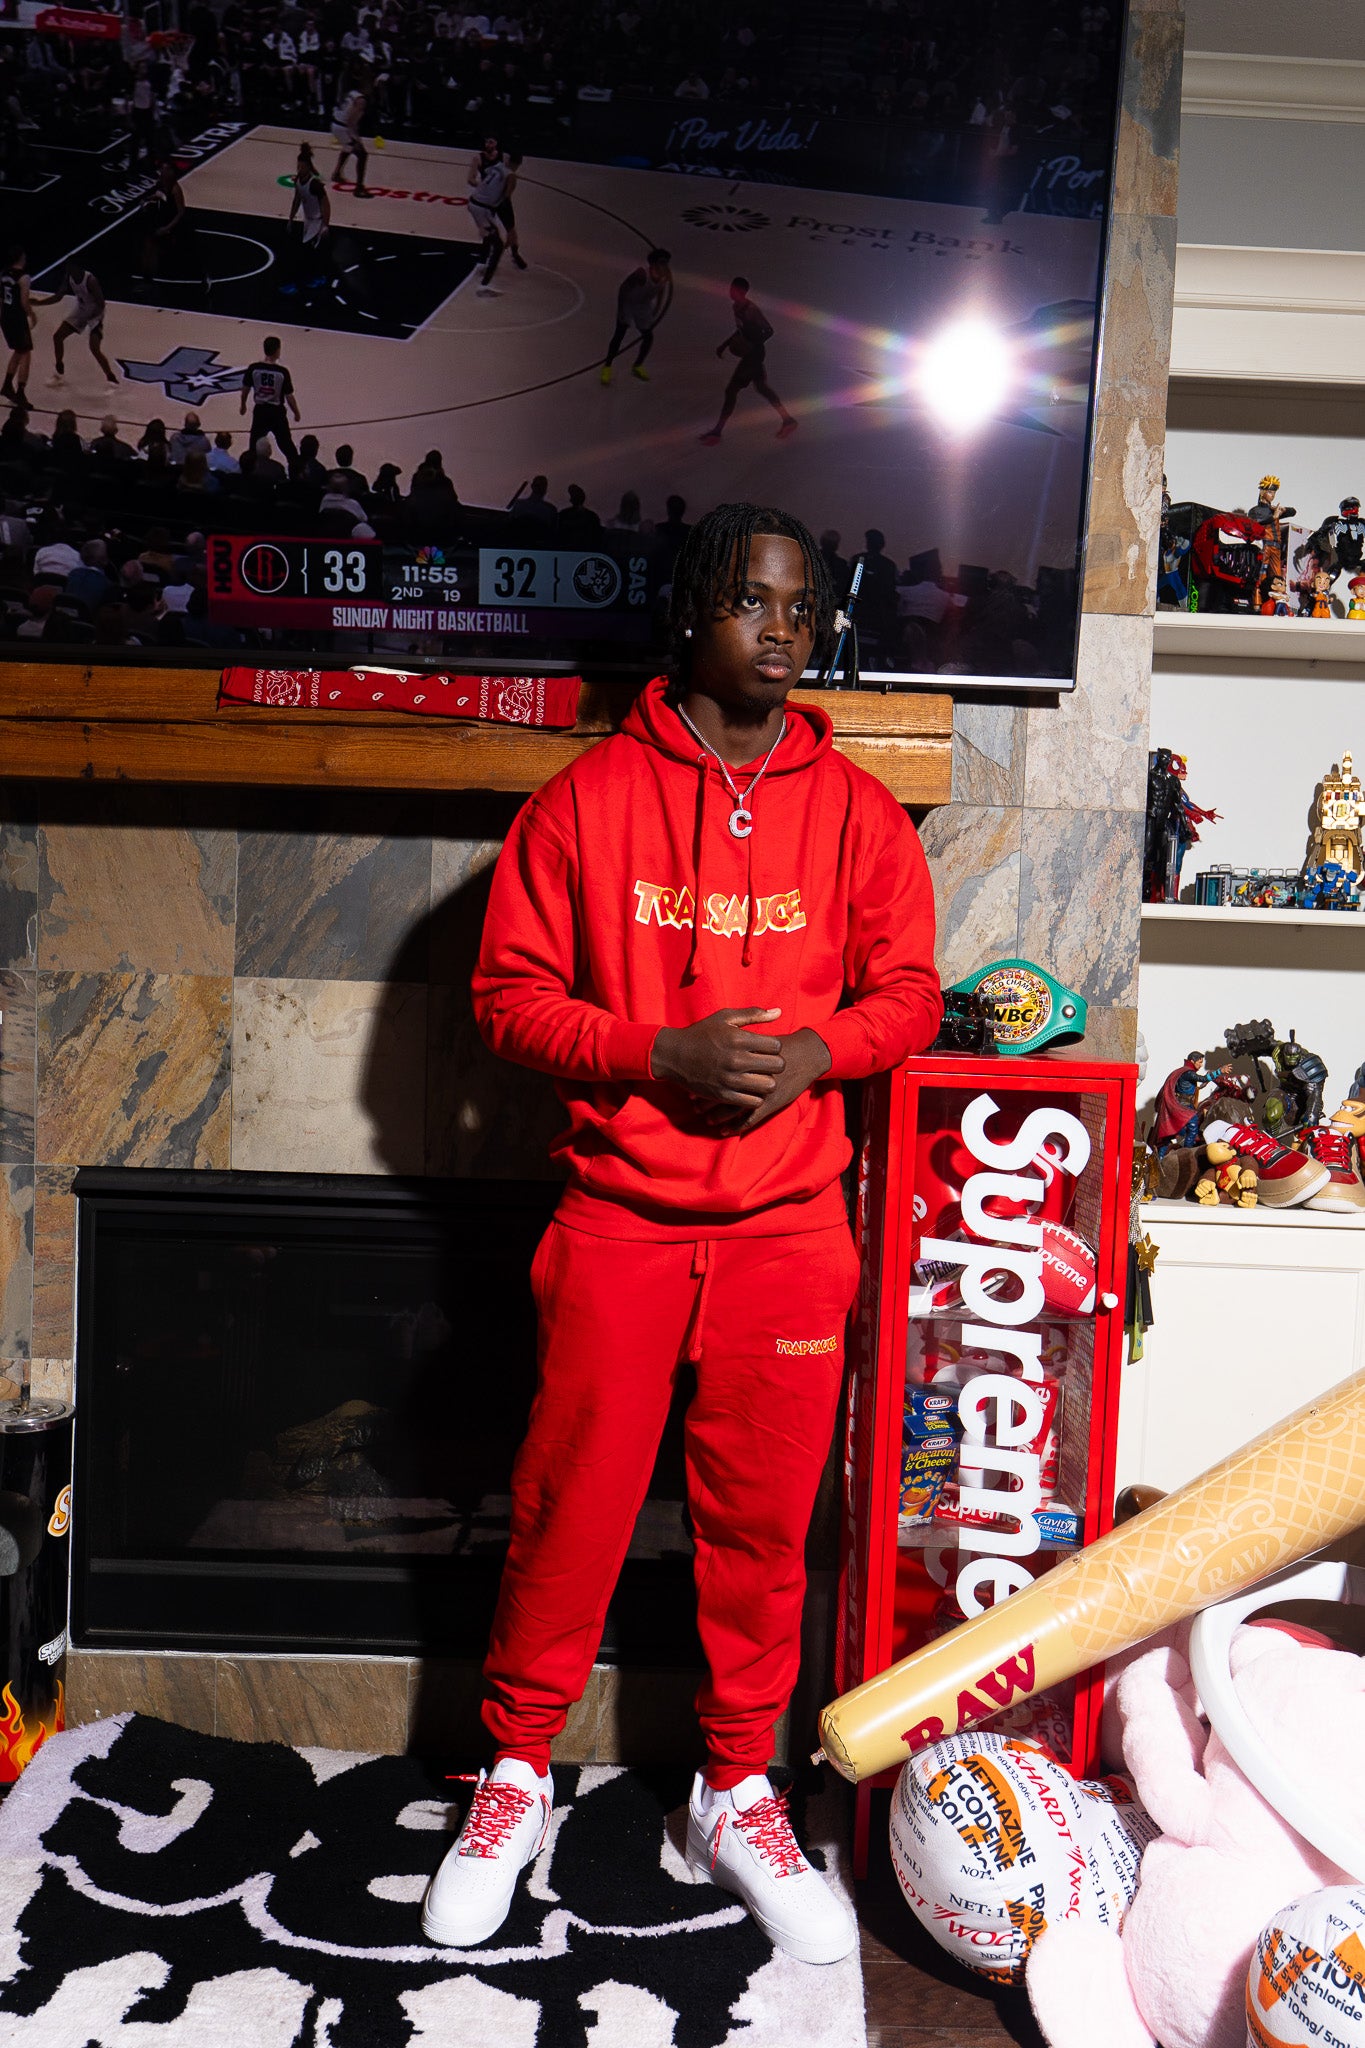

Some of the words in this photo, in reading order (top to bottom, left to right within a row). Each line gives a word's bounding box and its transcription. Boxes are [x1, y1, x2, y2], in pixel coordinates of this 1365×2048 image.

[735, 116, 820, 152] Vida!
[331, 182, 470, 206] Castro
[787, 216, 896, 240] Frost
[910, 230, 1024, 254] Bank
[213, 540, 232, 594] HOU
[323, 550, 367, 593] 33
[401, 565, 459, 585] 11:55
[494, 556, 537, 599] 32
[628, 556, 648, 606] SAS
[391, 586, 424, 601] 2ND
[442, 589, 461, 603] 19
[332, 606, 389, 629] SUNDAY
[392, 607, 435, 631] NIGHT
[437, 610, 530, 634] BASKETBALL
[634, 879, 807, 939] TRASAUCE
[920, 1092, 1091, 1620] Supreme
[907, 1448, 956, 1463] Macaroni
[915, 1458, 951, 1470] Cheese
[1037, 1515, 1072, 1531] Cavity
[1206, 1539, 1270, 1593] RAW
[900, 1642, 1039, 1756] RAW
[956, 1783, 1015, 1873] CODEINE
[949, 1892, 992, 1917] NET:
[1326, 1913, 1351, 1932] NOT
[1280, 1968, 1300, 1997] 5mL
[1300, 1992, 1309, 2006] &
[1285, 1950, 1363, 2021] Hydrochloride
[1287, 1997, 1325, 2036] 10mg/
